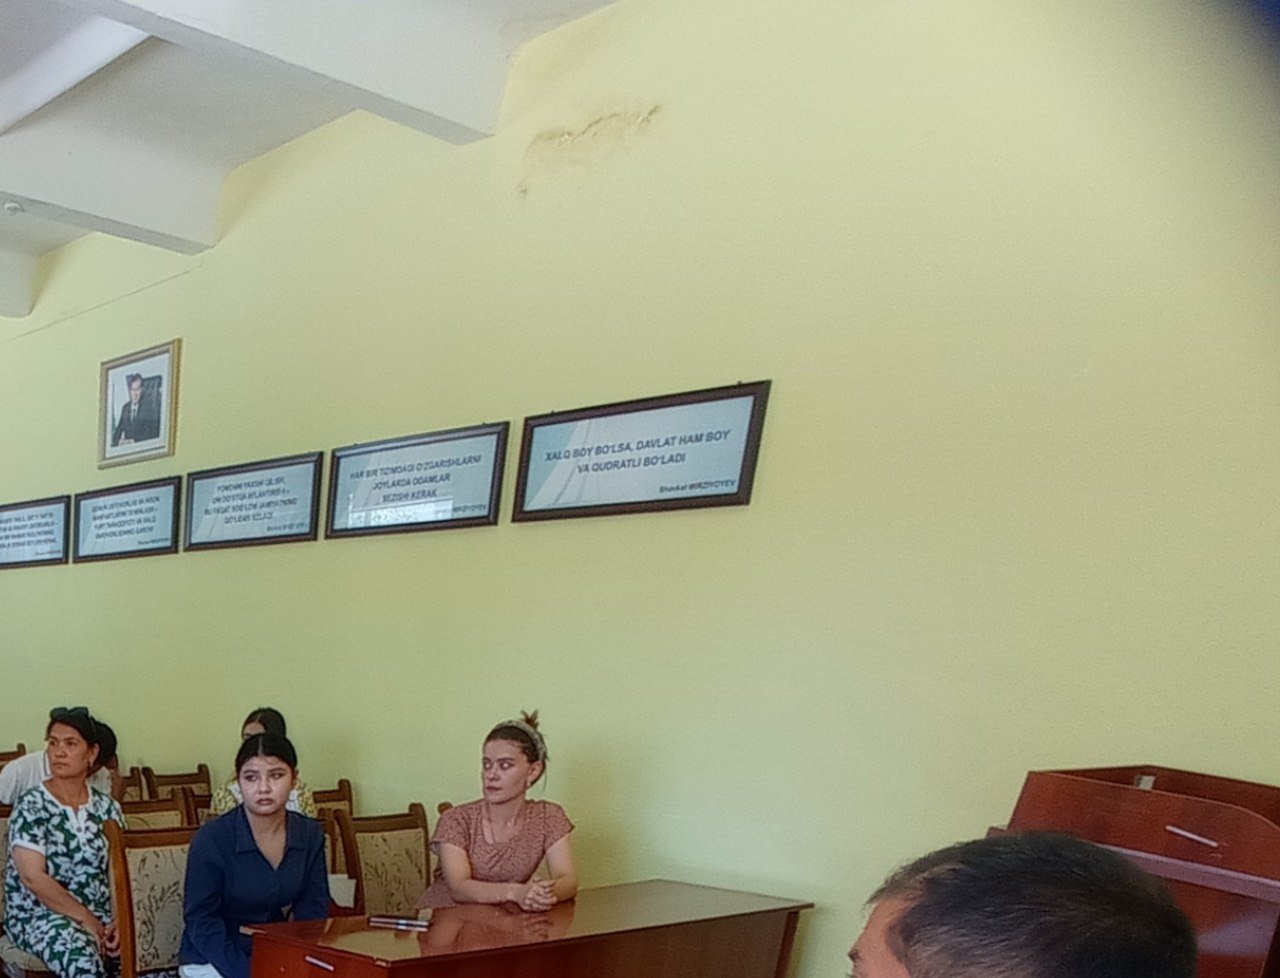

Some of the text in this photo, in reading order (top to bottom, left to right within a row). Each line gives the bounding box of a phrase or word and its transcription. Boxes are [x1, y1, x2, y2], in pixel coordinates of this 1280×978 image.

[545, 450, 571, 462] XALQ
[573, 447, 594, 459] BOY
[636, 436, 678, 451] DAVLAT
[679, 432, 704, 446] HAM
[705, 429, 732, 442] BOY
[578, 464, 590, 474] VA
[592, 457, 642, 473] QUDRATLI
